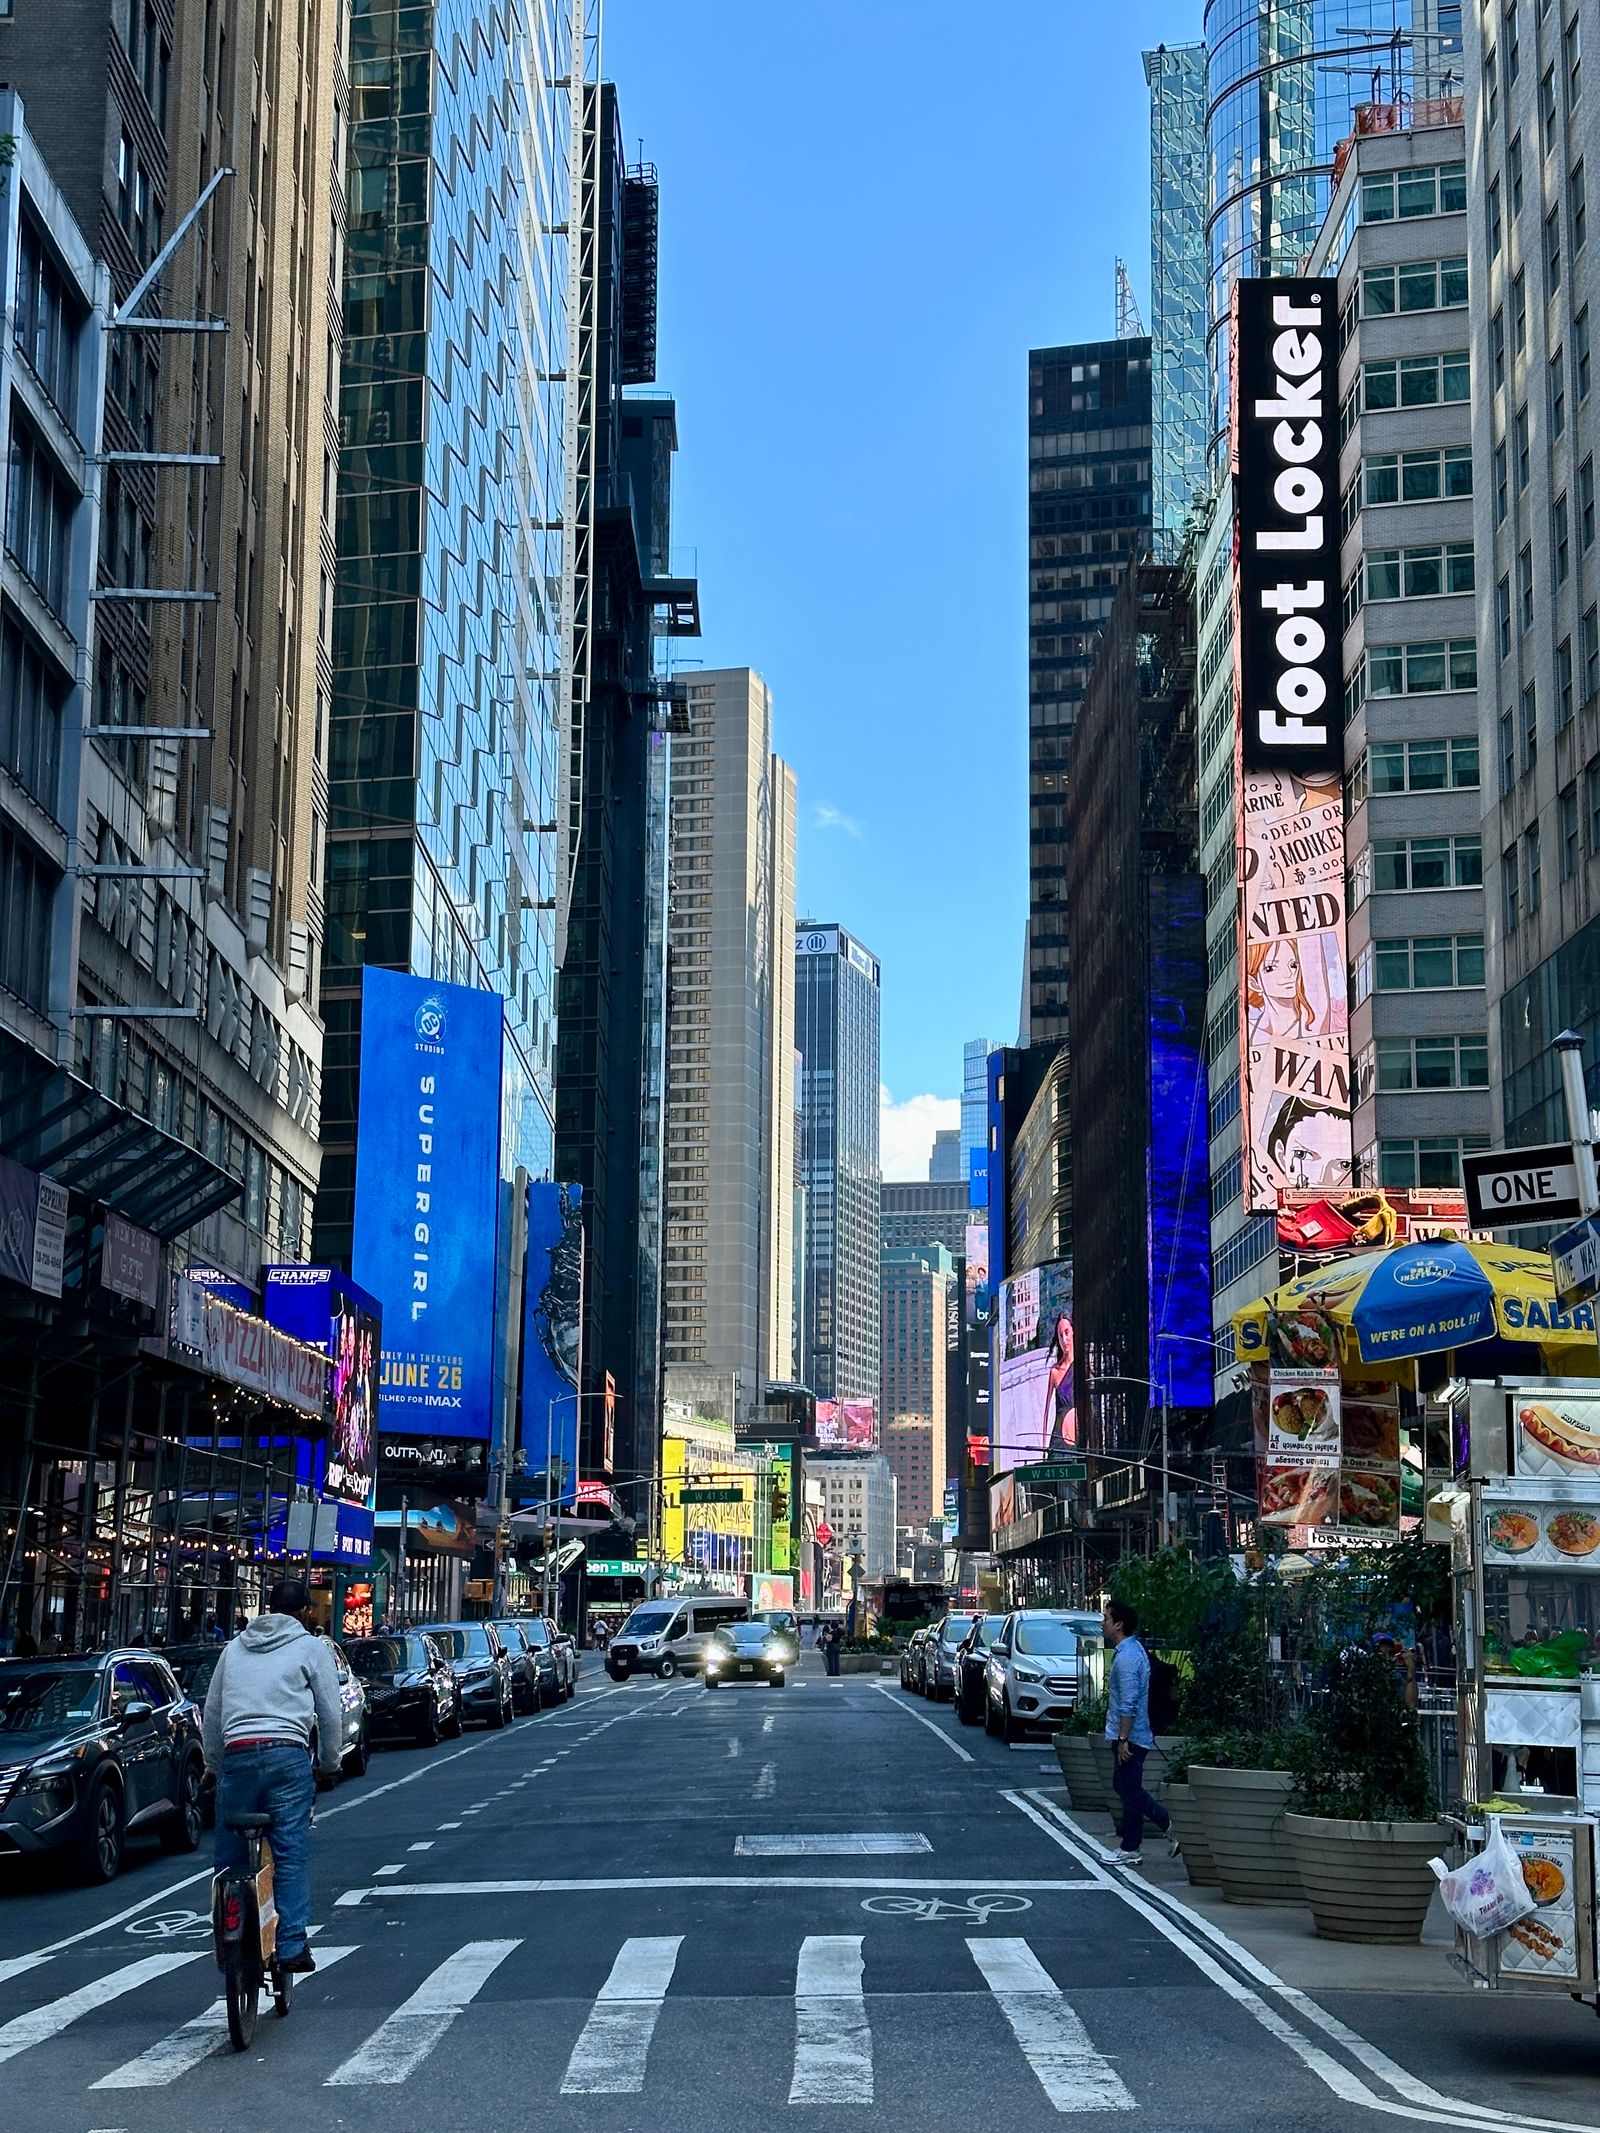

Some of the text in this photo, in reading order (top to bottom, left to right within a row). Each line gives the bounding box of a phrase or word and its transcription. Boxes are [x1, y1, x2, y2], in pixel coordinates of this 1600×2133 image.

[1270, 816, 1312, 840] DEAD
[415, 1043, 445, 1055] STUDIOS
[1491, 1170, 1558, 1204] ONE
[411, 1075, 436, 1322] SUPERGIRL
[270, 1271, 328, 1280] CHAMPS
[1558, 1255, 1576, 1289] ONE
[1370, 1329, 1406, 1344] WE'RE
[1409, 1325, 1425, 1338] ON
[1428, 1325, 1436, 1334] A
[1439, 1317, 1466, 1333] ROLL
[380, 1350, 463, 1365] ONLY IN THEATERS
[380, 1362, 462, 1390] JUNE 26
[1273, 1369, 1296, 1377] Chicken
[407, 1395, 423, 1404] FOR
[424, 1395, 462, 1408] IMAX
[1560, 1414, 1575, 1425] HOT
[1367, 1460, 1384, 1469] Rice
[1031, 1468, 1069, 1479] W 41 St
[694, 1490, 728, 1501] W 41 St
[621, 1562, 648, 1574] Buy
